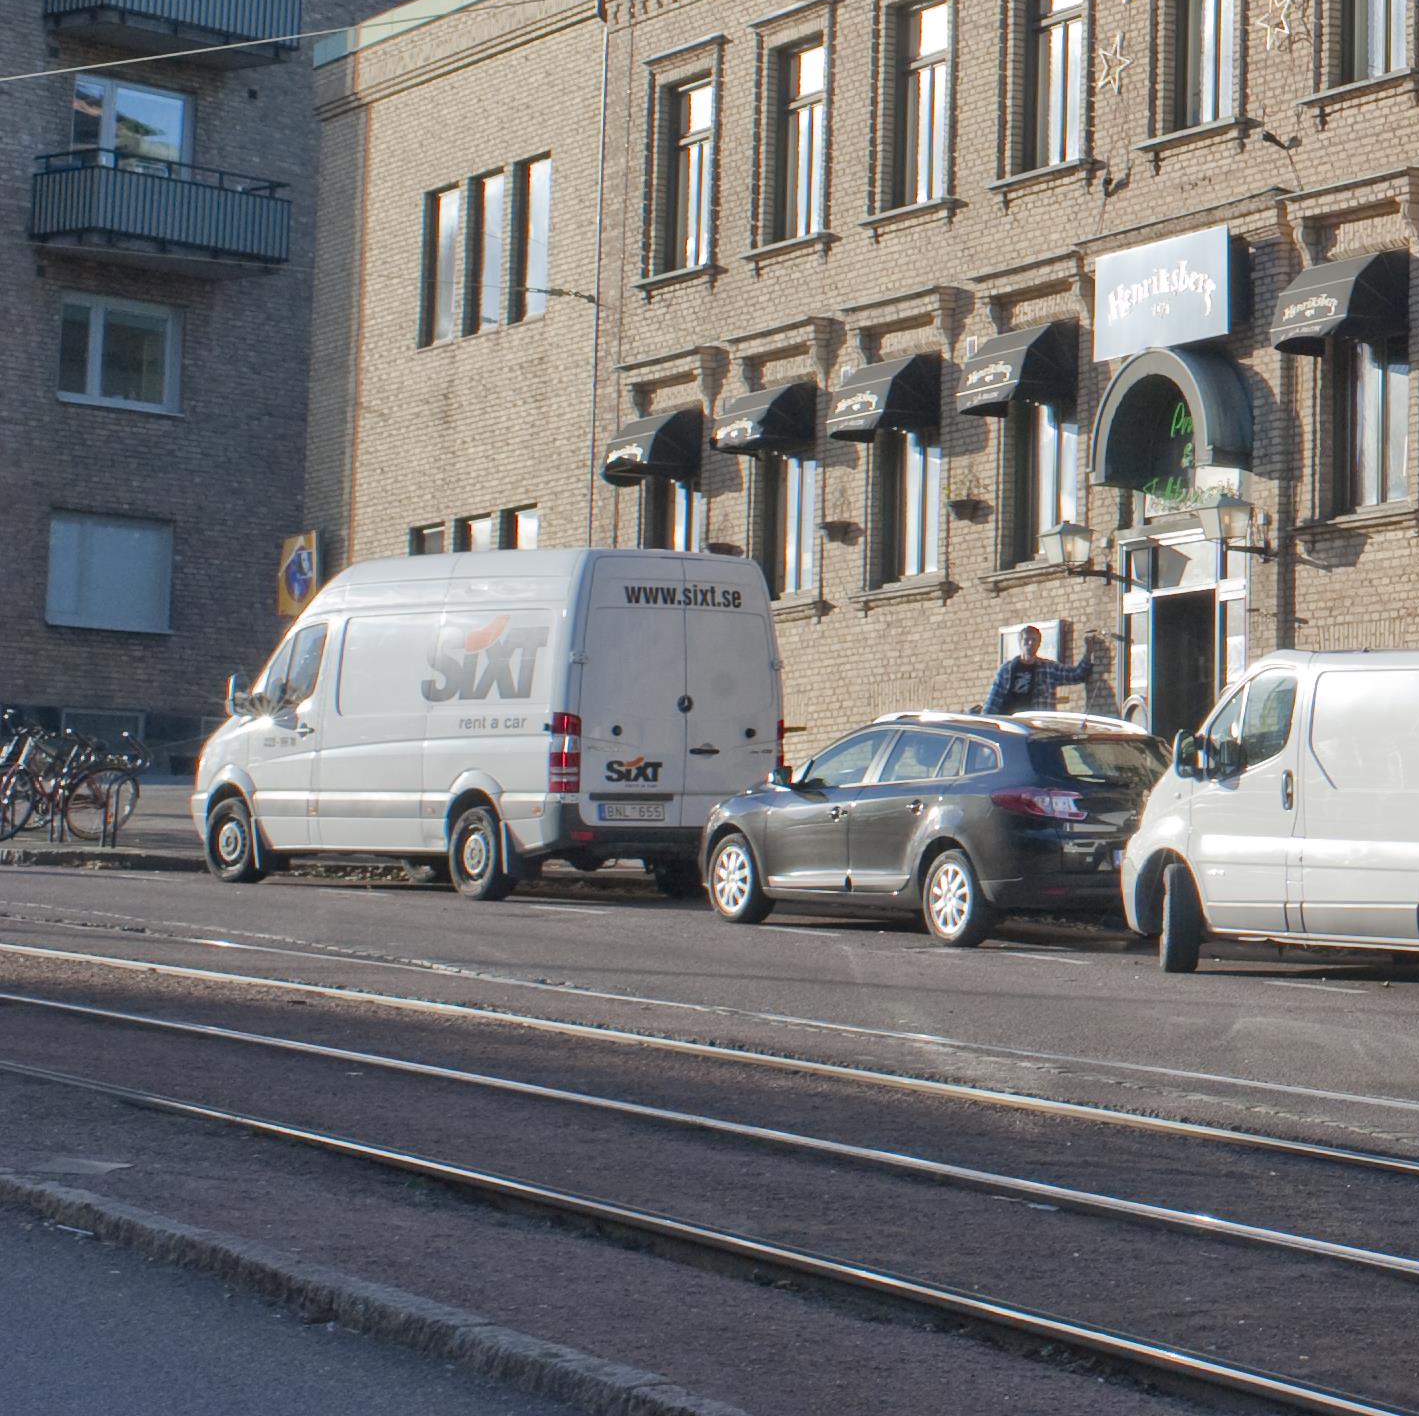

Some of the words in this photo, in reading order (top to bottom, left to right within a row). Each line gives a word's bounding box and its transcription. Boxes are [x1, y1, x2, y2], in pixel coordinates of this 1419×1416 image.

[624, 584, 742, 609] www.sixt.se
[459, 716, 487, 729] rent
[490, 718, 499, 729] a
[504, 716, 527, 729] car
[607, 805, 630, 818] BNL
